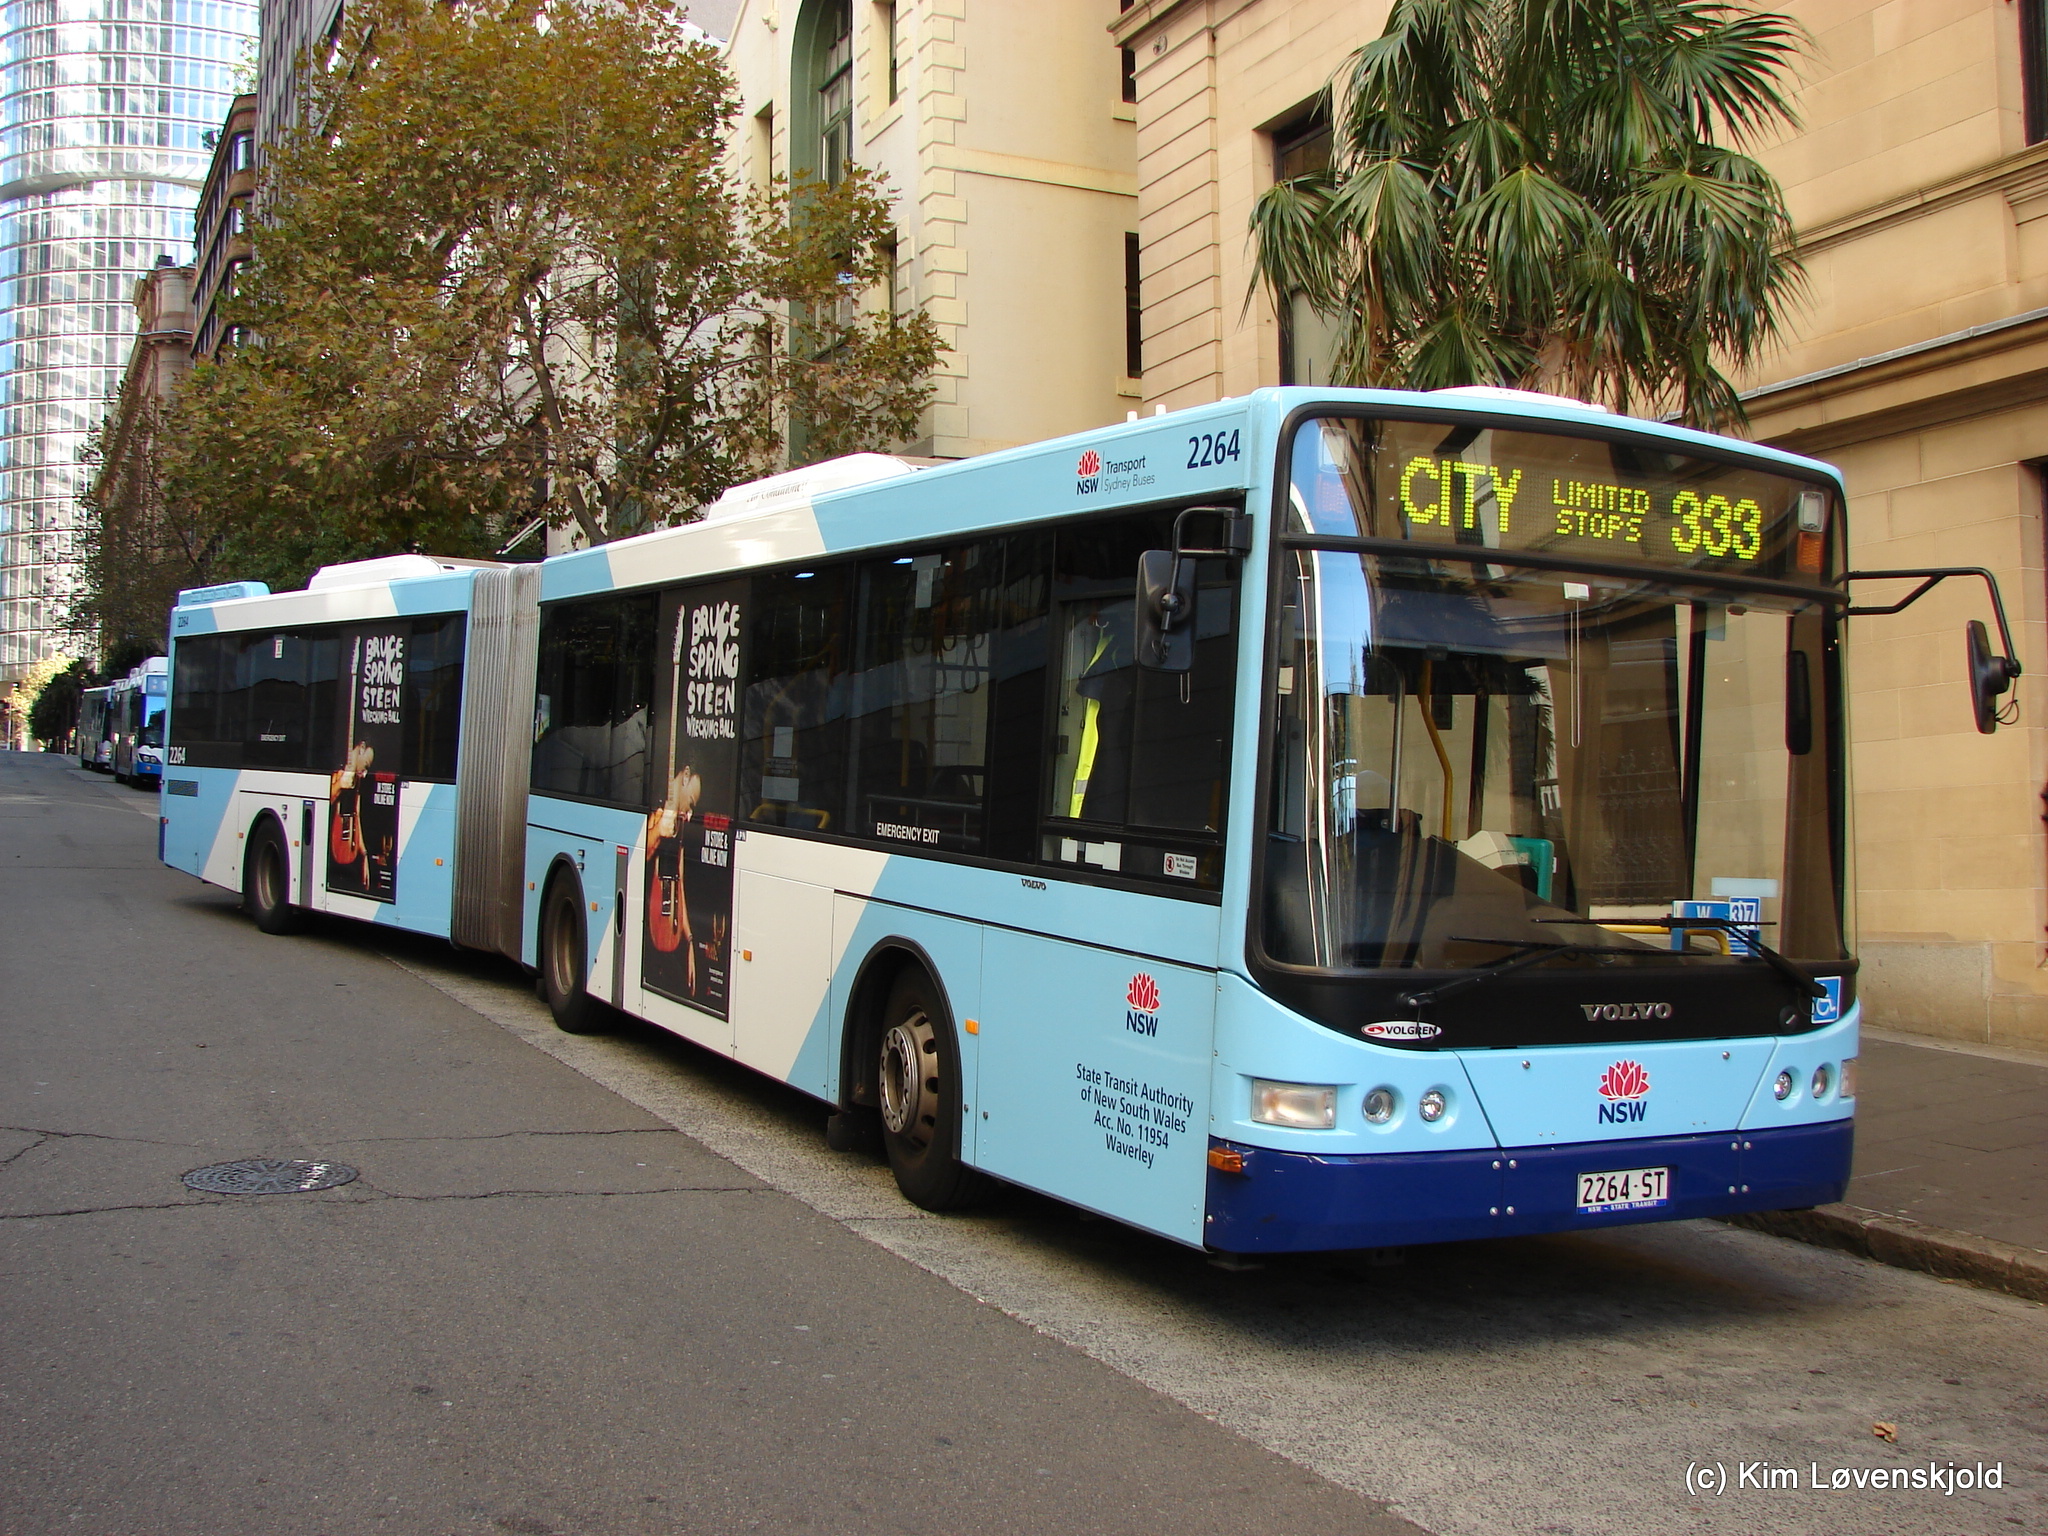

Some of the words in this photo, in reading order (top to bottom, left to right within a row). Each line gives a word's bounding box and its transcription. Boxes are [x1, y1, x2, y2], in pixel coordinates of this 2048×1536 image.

[1187, 428, 1241, 470] 2264
[1106, 454, 1146, 475] Transport
[1077, 477, 1099, 496] NSW
[1104, 478, 1131, 495] Sydney
[1133, 473, 1155, 487] Buses
[1400, 456, 1522, 533] CITY
[1553, 478, 1650, 516] LIMITED
[1555, 509, 1643, 542] STOPS
[1670, 490, 1762, 560] 333
[178, 616, 189, 628] 2264
[691, 600, 740, 646] BRUCE
[366, 635, 404, 663] BRUCE
[689, 641, 740, 681] SPRING
[363, 660, 403, 686] SPRING
[363, 686, 400, 709] STEEN
[687, 680, 736, 716] STEEN
[686, 715, 719, 739] WRECKING
[720, 717, 735, 739] BALL
[169, 747, 186, 764] 2264
[876, 822, 922, 841] EMERGENCY
[922, 828, 940, 844] EXIT
[1021, 878, 1047, 890] VOLVO
[1696, 905, 1711, 919] W
[1126, 1010, 1158, 1037] NSW
[1580, 1001, 1673, 1022] VOLVO
[1386, 1025, 1437, 1036] VOLGREN
[1076, 1062, 1102, 1086] State
[1104, 1070, 1138, 1097] Transit
[1140, 1082, 1194, 1118] Authority
[1081, 1086, 1092, 1100] of
[1094, 1088, 1117, 1110] New
[1119, 1096, 1150, 1122] South
[1153, 1108, 1186, 1133] Wales
[1598, 1101, 1647, 1124] NSW
[1094, 1109, 1114, 1131] Acc.
[1117, 1116, 1134, 1138] No.
[1138, 1124, 1169, 1149] 11954
[1105, 1132, 1154, 1169] Waverley
[1587, 1205, 1601, 1213] NSW
[1611, 1202, 1629, 1211] STATE
[1632, 1200, 1658, 1209] TRANSIT
